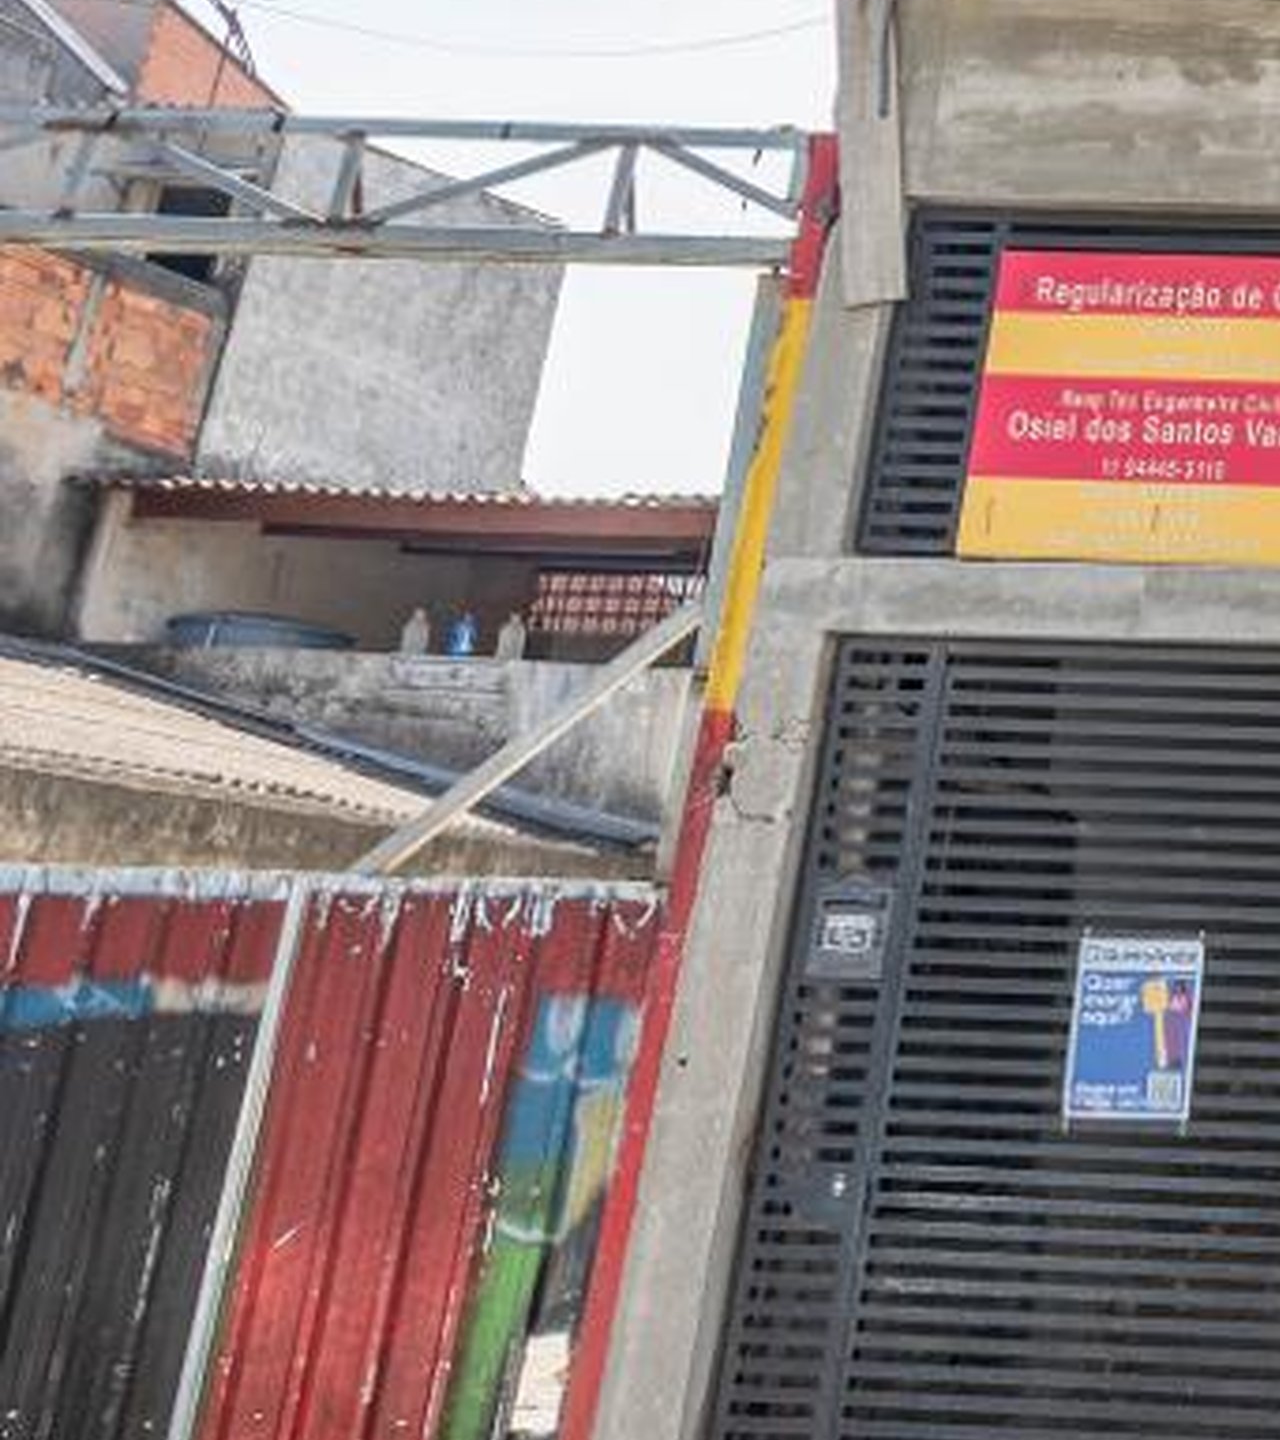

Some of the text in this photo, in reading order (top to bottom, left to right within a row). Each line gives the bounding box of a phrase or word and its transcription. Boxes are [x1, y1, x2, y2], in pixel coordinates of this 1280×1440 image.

[1037, 277, 1221, 316] Regularização
[1232, 284, 1261, 310] de
[1007, 410, 1078, 441] Osiel
[1086, 415, 1132, 443] dos
[1142, 415, 1234, 445] Santos
